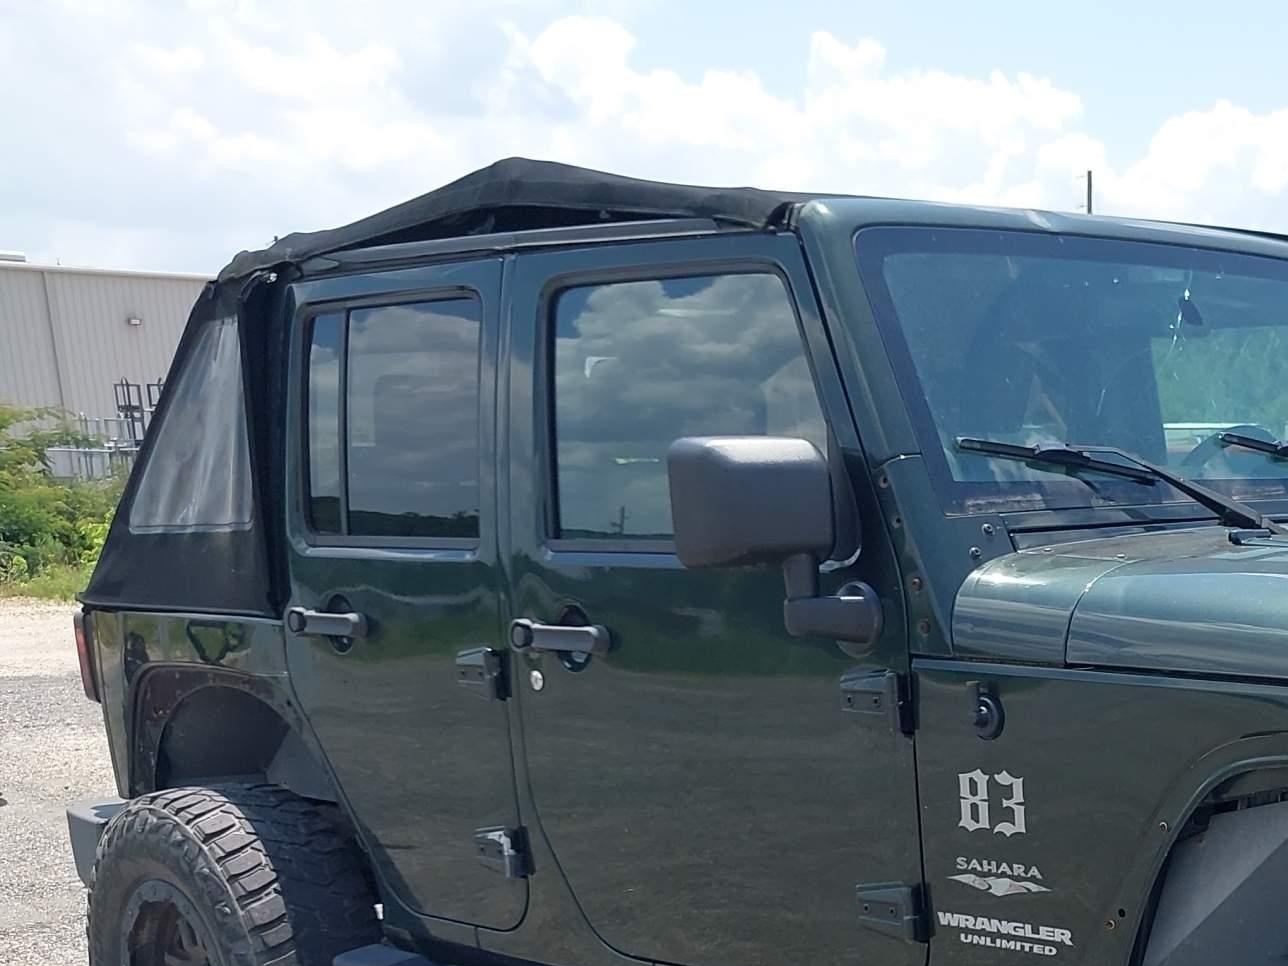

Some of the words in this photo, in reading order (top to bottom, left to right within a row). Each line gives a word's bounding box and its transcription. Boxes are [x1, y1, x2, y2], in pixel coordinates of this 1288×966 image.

[958, 768, 1026, 837] 83
[956, 856, 1042, 879] SAHARA
[937, 911, 1074, 946] WRANGLER
[960, 933, 1058, 957] UNLIMITED
